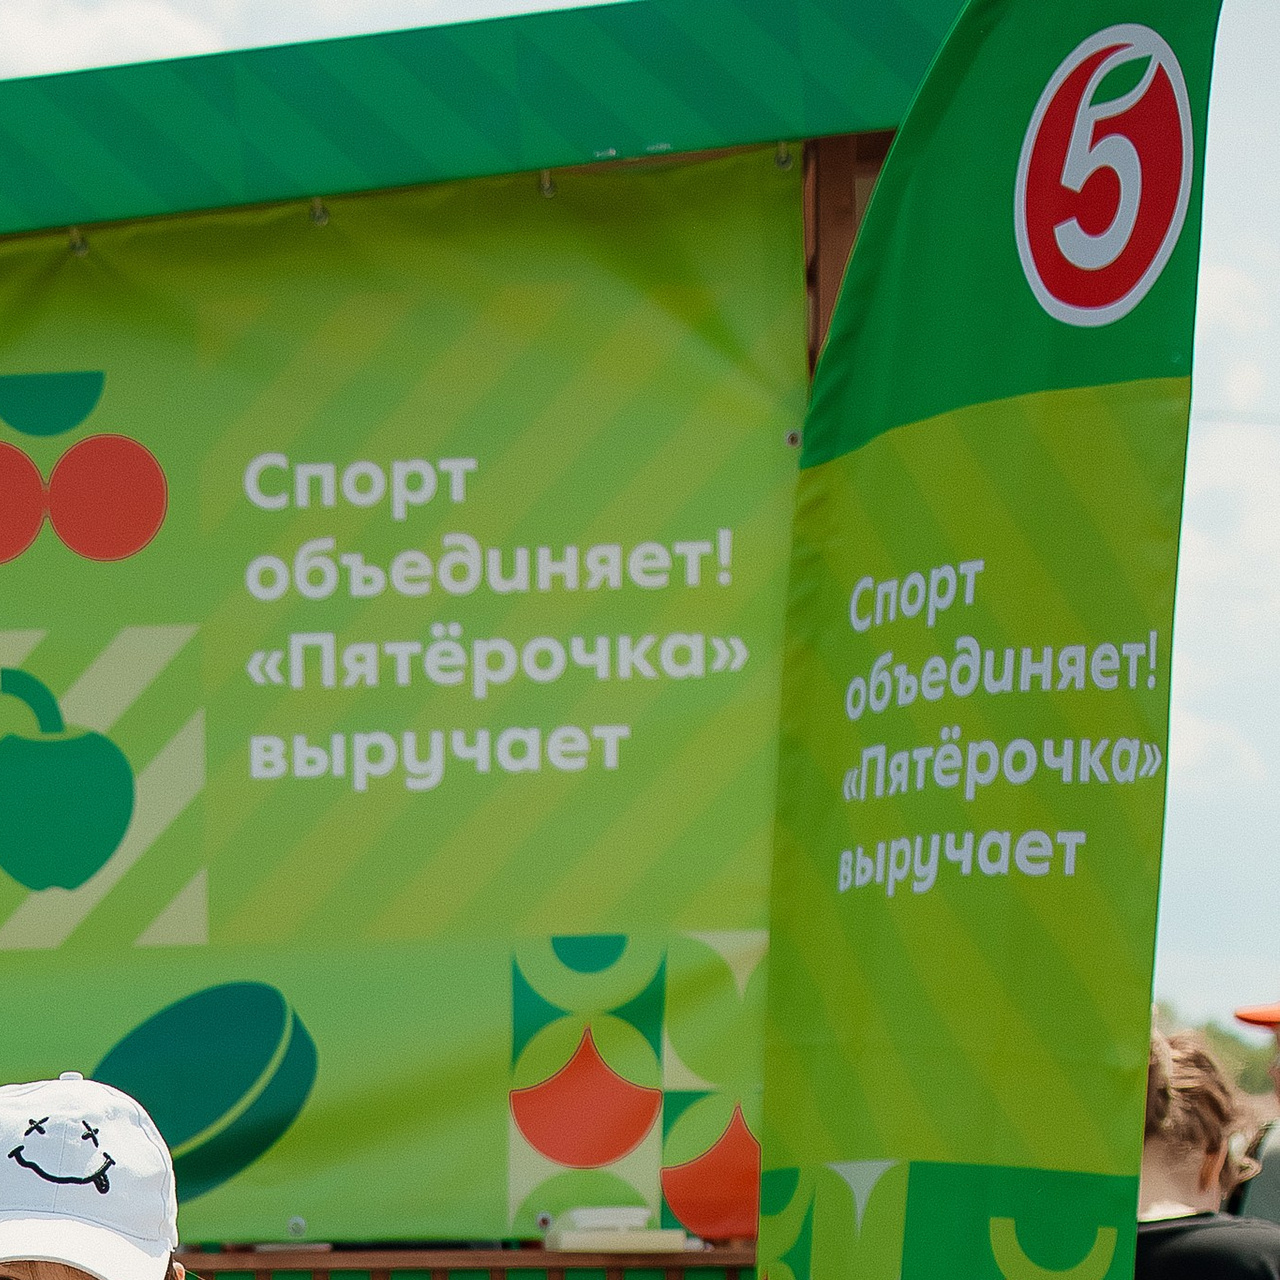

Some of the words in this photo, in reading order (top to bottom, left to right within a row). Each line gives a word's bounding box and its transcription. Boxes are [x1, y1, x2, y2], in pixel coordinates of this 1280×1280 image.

[243, 452, 478, 521] Спорт
[245, 528, 733, 600] объединяет!
[849, 558, 985, 632] Спорт
[246, 622, 750, 699] «Пятёрочка»
[845, 630, 1158, 721] объединяет!
[249, 723, 631, 792] выручает
[842, 725, 1162, 801] «Пятёрочка»
[837, 829, 1087, 898] выручает
